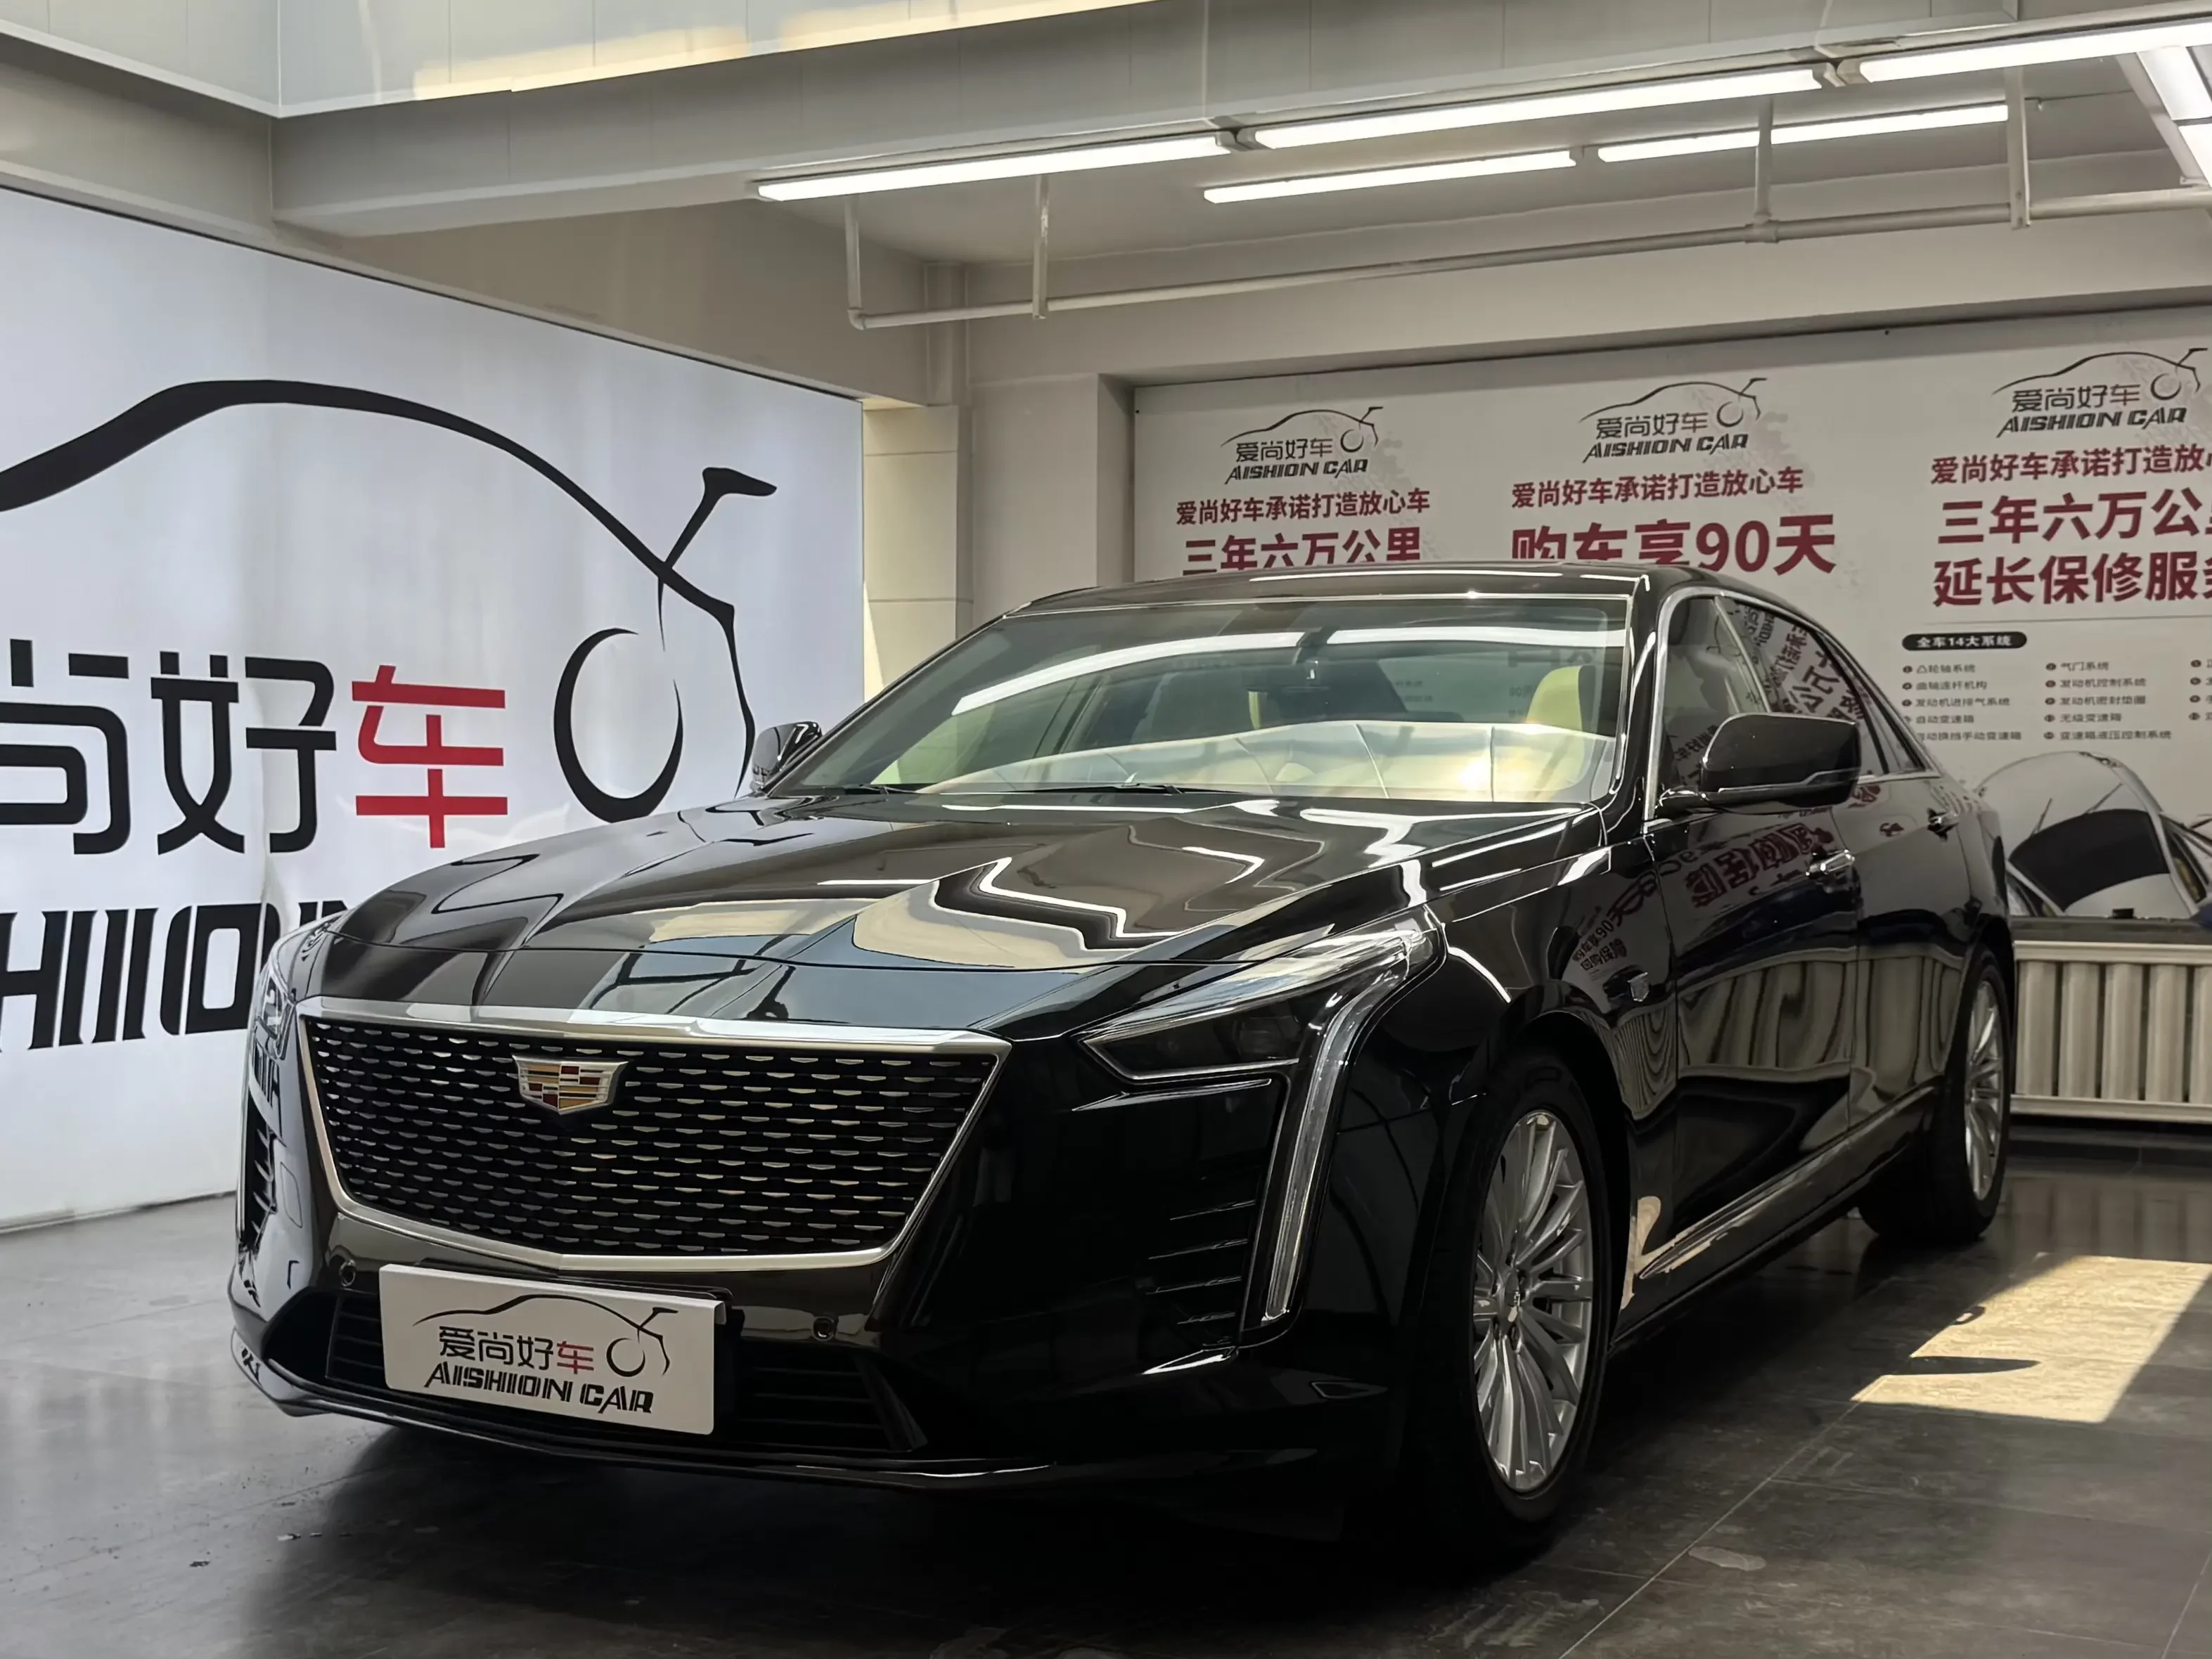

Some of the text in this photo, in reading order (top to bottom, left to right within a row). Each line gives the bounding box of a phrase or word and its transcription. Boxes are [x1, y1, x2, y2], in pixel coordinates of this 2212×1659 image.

[2012, 384, 2141, 413] 爱尚好车
[1595, 411, 1709, 439] 爱尚好车
[1995, 407, 2187, 438] AISHION CAR
[1235, 437, 1333, 463] 爱尚好车
[1582, 433, 1749, 463] AISHION CAR
[1930, 443, 2212, 485] 爱尚好车承诺打造放
[1225, 458, 1369, 485] AISHION CAR
[1511, 466, 1803, 508] 爱尚好车承诺打造放心车
[1176, 487, 1430, 526] 爱尚好车承诺打造放心车
[1937, 487, 2212, 544] 三年六万公
[1183, 527, 1420, 576] 三年六万公里
[1932, 551, 2212, 607] 延长保修服
[1917, 635, 2012, 648] 全车14大系统
[439, 1325, 595, 1375] 爱尚好车
[423, 1361, 655, 1414] AISHION CAR
